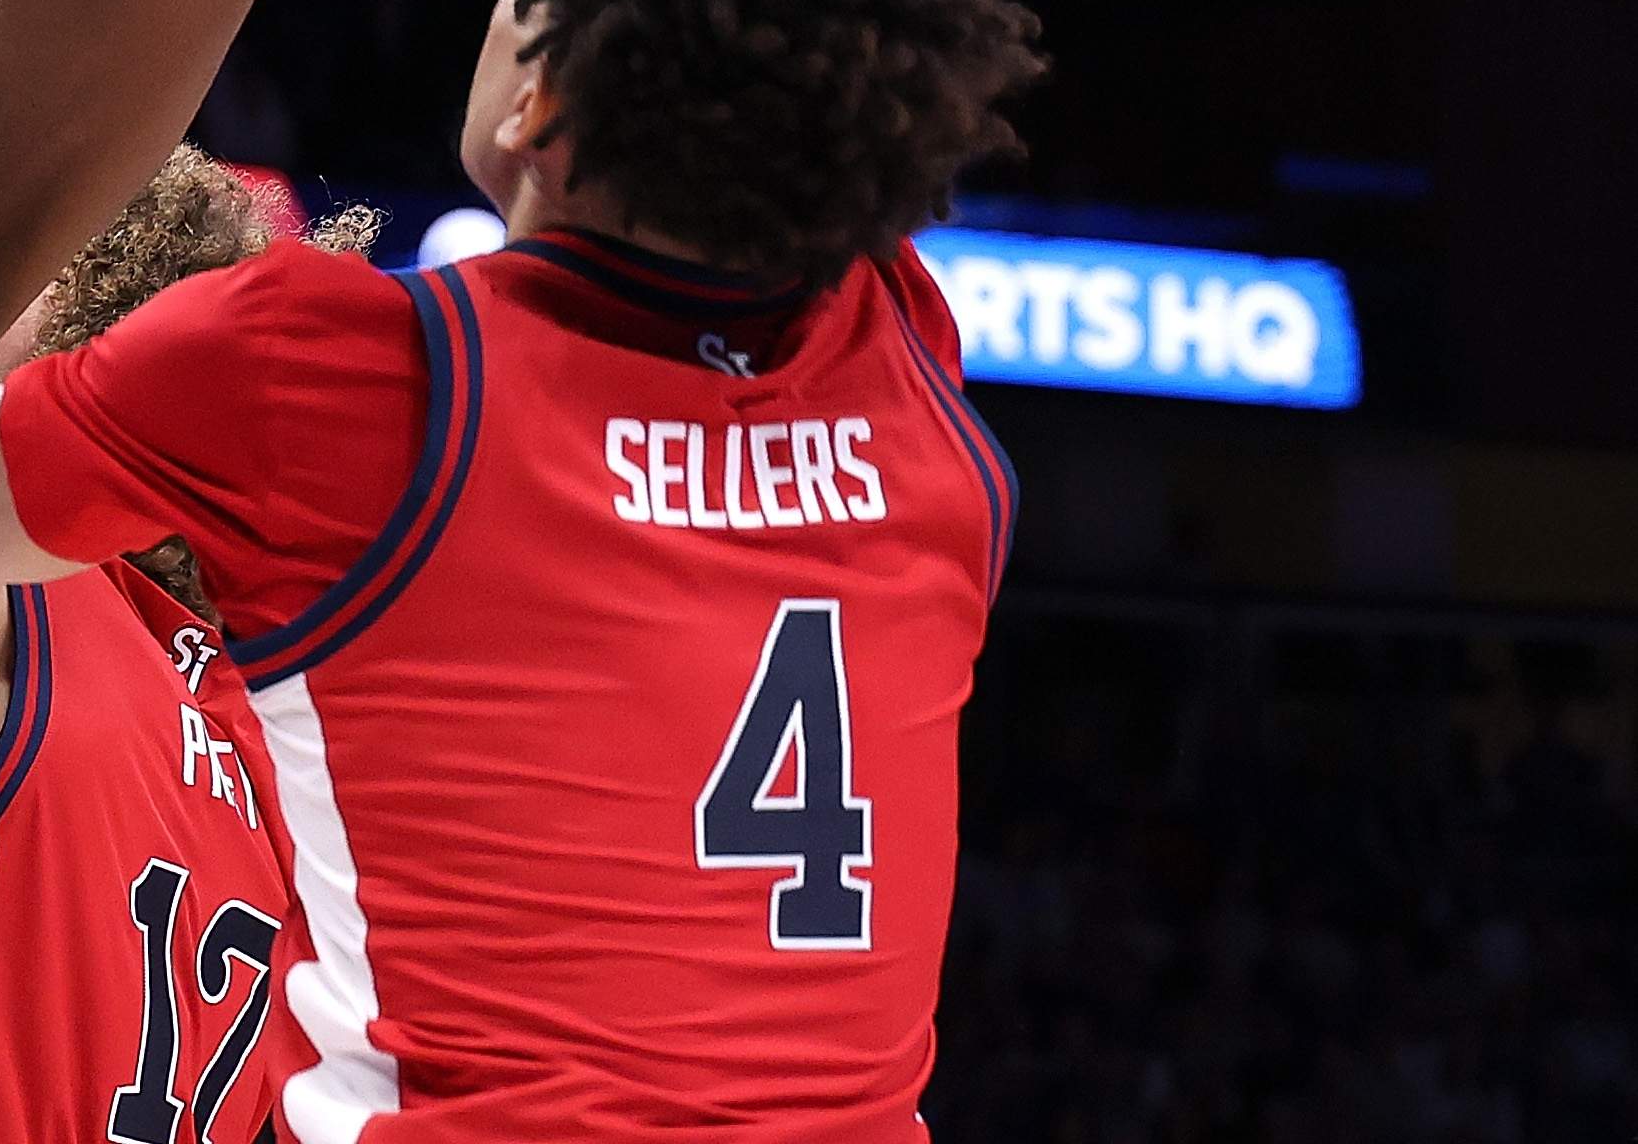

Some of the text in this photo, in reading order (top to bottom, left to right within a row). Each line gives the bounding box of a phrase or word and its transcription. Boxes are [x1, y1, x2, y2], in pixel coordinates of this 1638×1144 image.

[919, 254, 1321, 390] RTS HQ
[605, 416, 887, 530] SELLERS
[693, 598, 873, 952] 4
